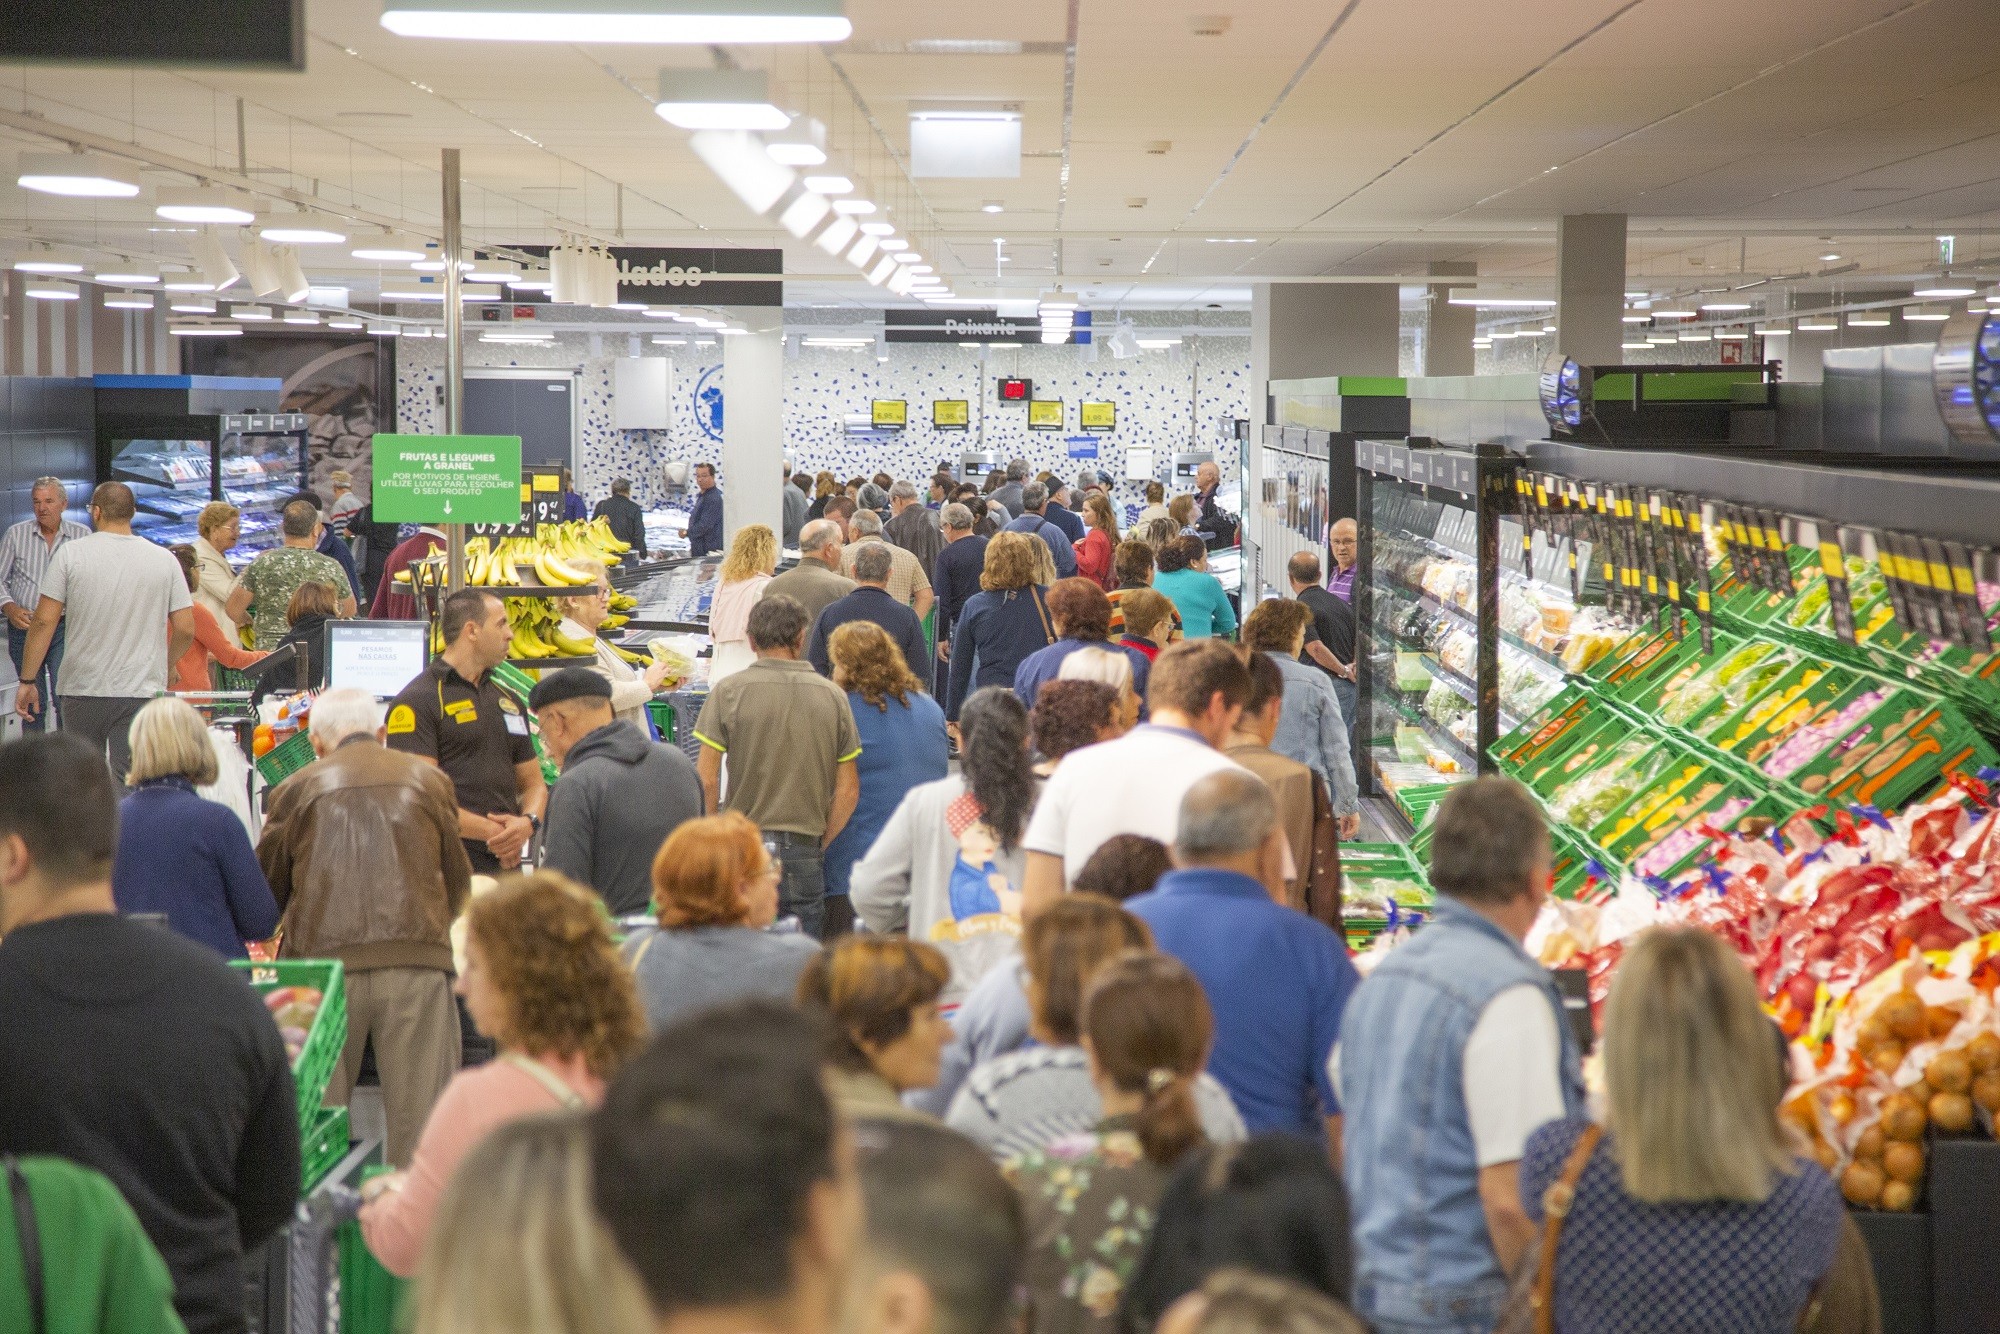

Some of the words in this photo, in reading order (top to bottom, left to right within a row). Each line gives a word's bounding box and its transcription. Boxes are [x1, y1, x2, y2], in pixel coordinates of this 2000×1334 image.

[617, 259, 701, 286] lados
[946, 318, 1016, 335] Peixaria
[400, 453, 438, 461] FRUTAS
[440, 453, 447, 461] E
[449, 453, 496, 462] LEGUMES
[434, 462, 475, 470] GRANEL
